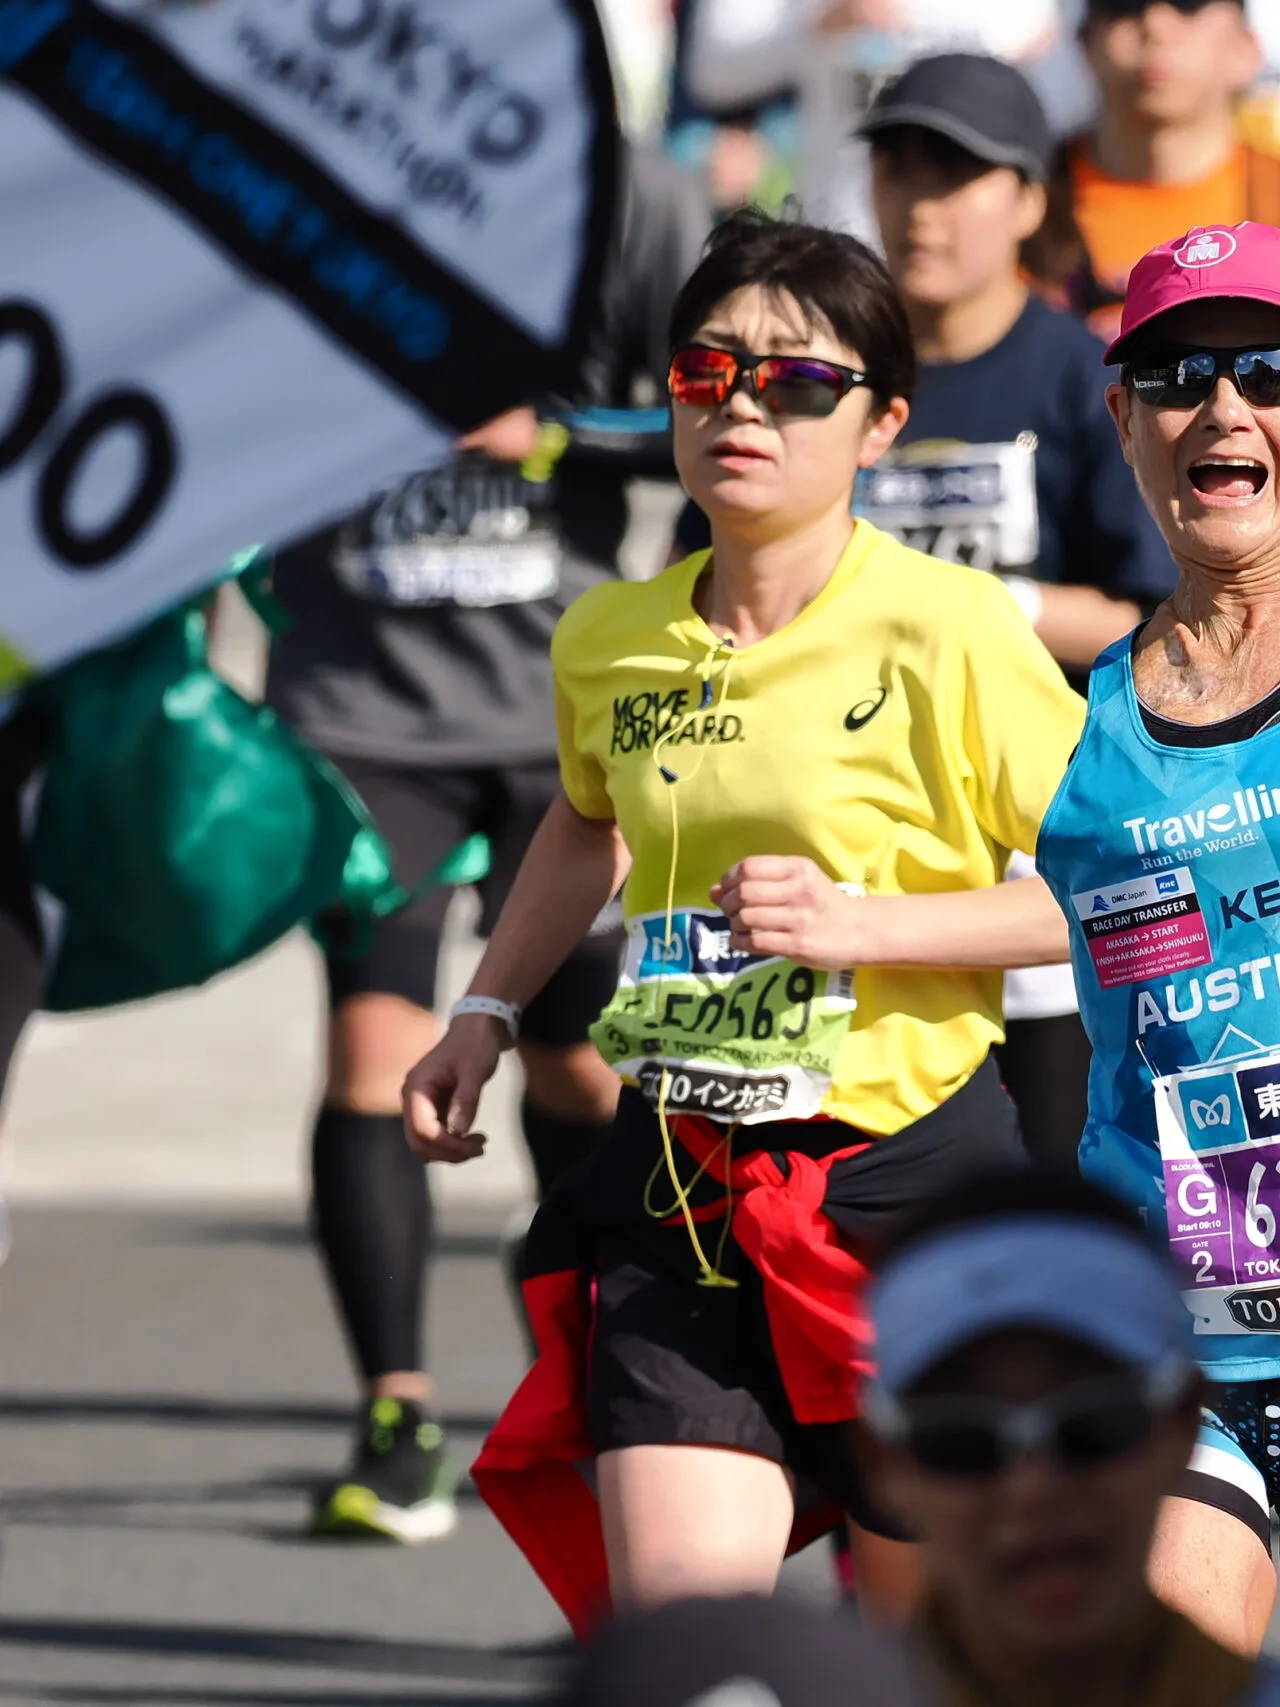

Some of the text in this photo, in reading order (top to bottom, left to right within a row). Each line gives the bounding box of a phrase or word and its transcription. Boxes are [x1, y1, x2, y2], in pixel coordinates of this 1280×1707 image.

[613, 688, 689, 724] MOVE
[1141, 829, 1260, 871] Run the World.
[1111, 893, 1127, 904] DMC
[1127, 890, 1147, 901] Japan
[1092, 900, 1189, 933] RACE DAY TRANSFER
[1106, 923, 1180, 950] AKASAKA START
[1120, 945, 1156, 961] AKASAKA
[1162, 932, 1204, 950] SHINJUKU
[1177, 1173, 1217, 1217] G
[1177, 1222, 1198, 1232] Start
[1192, 1241, 1208, 1249] GATE
[1191, 1250, 1216, 1282] 2
